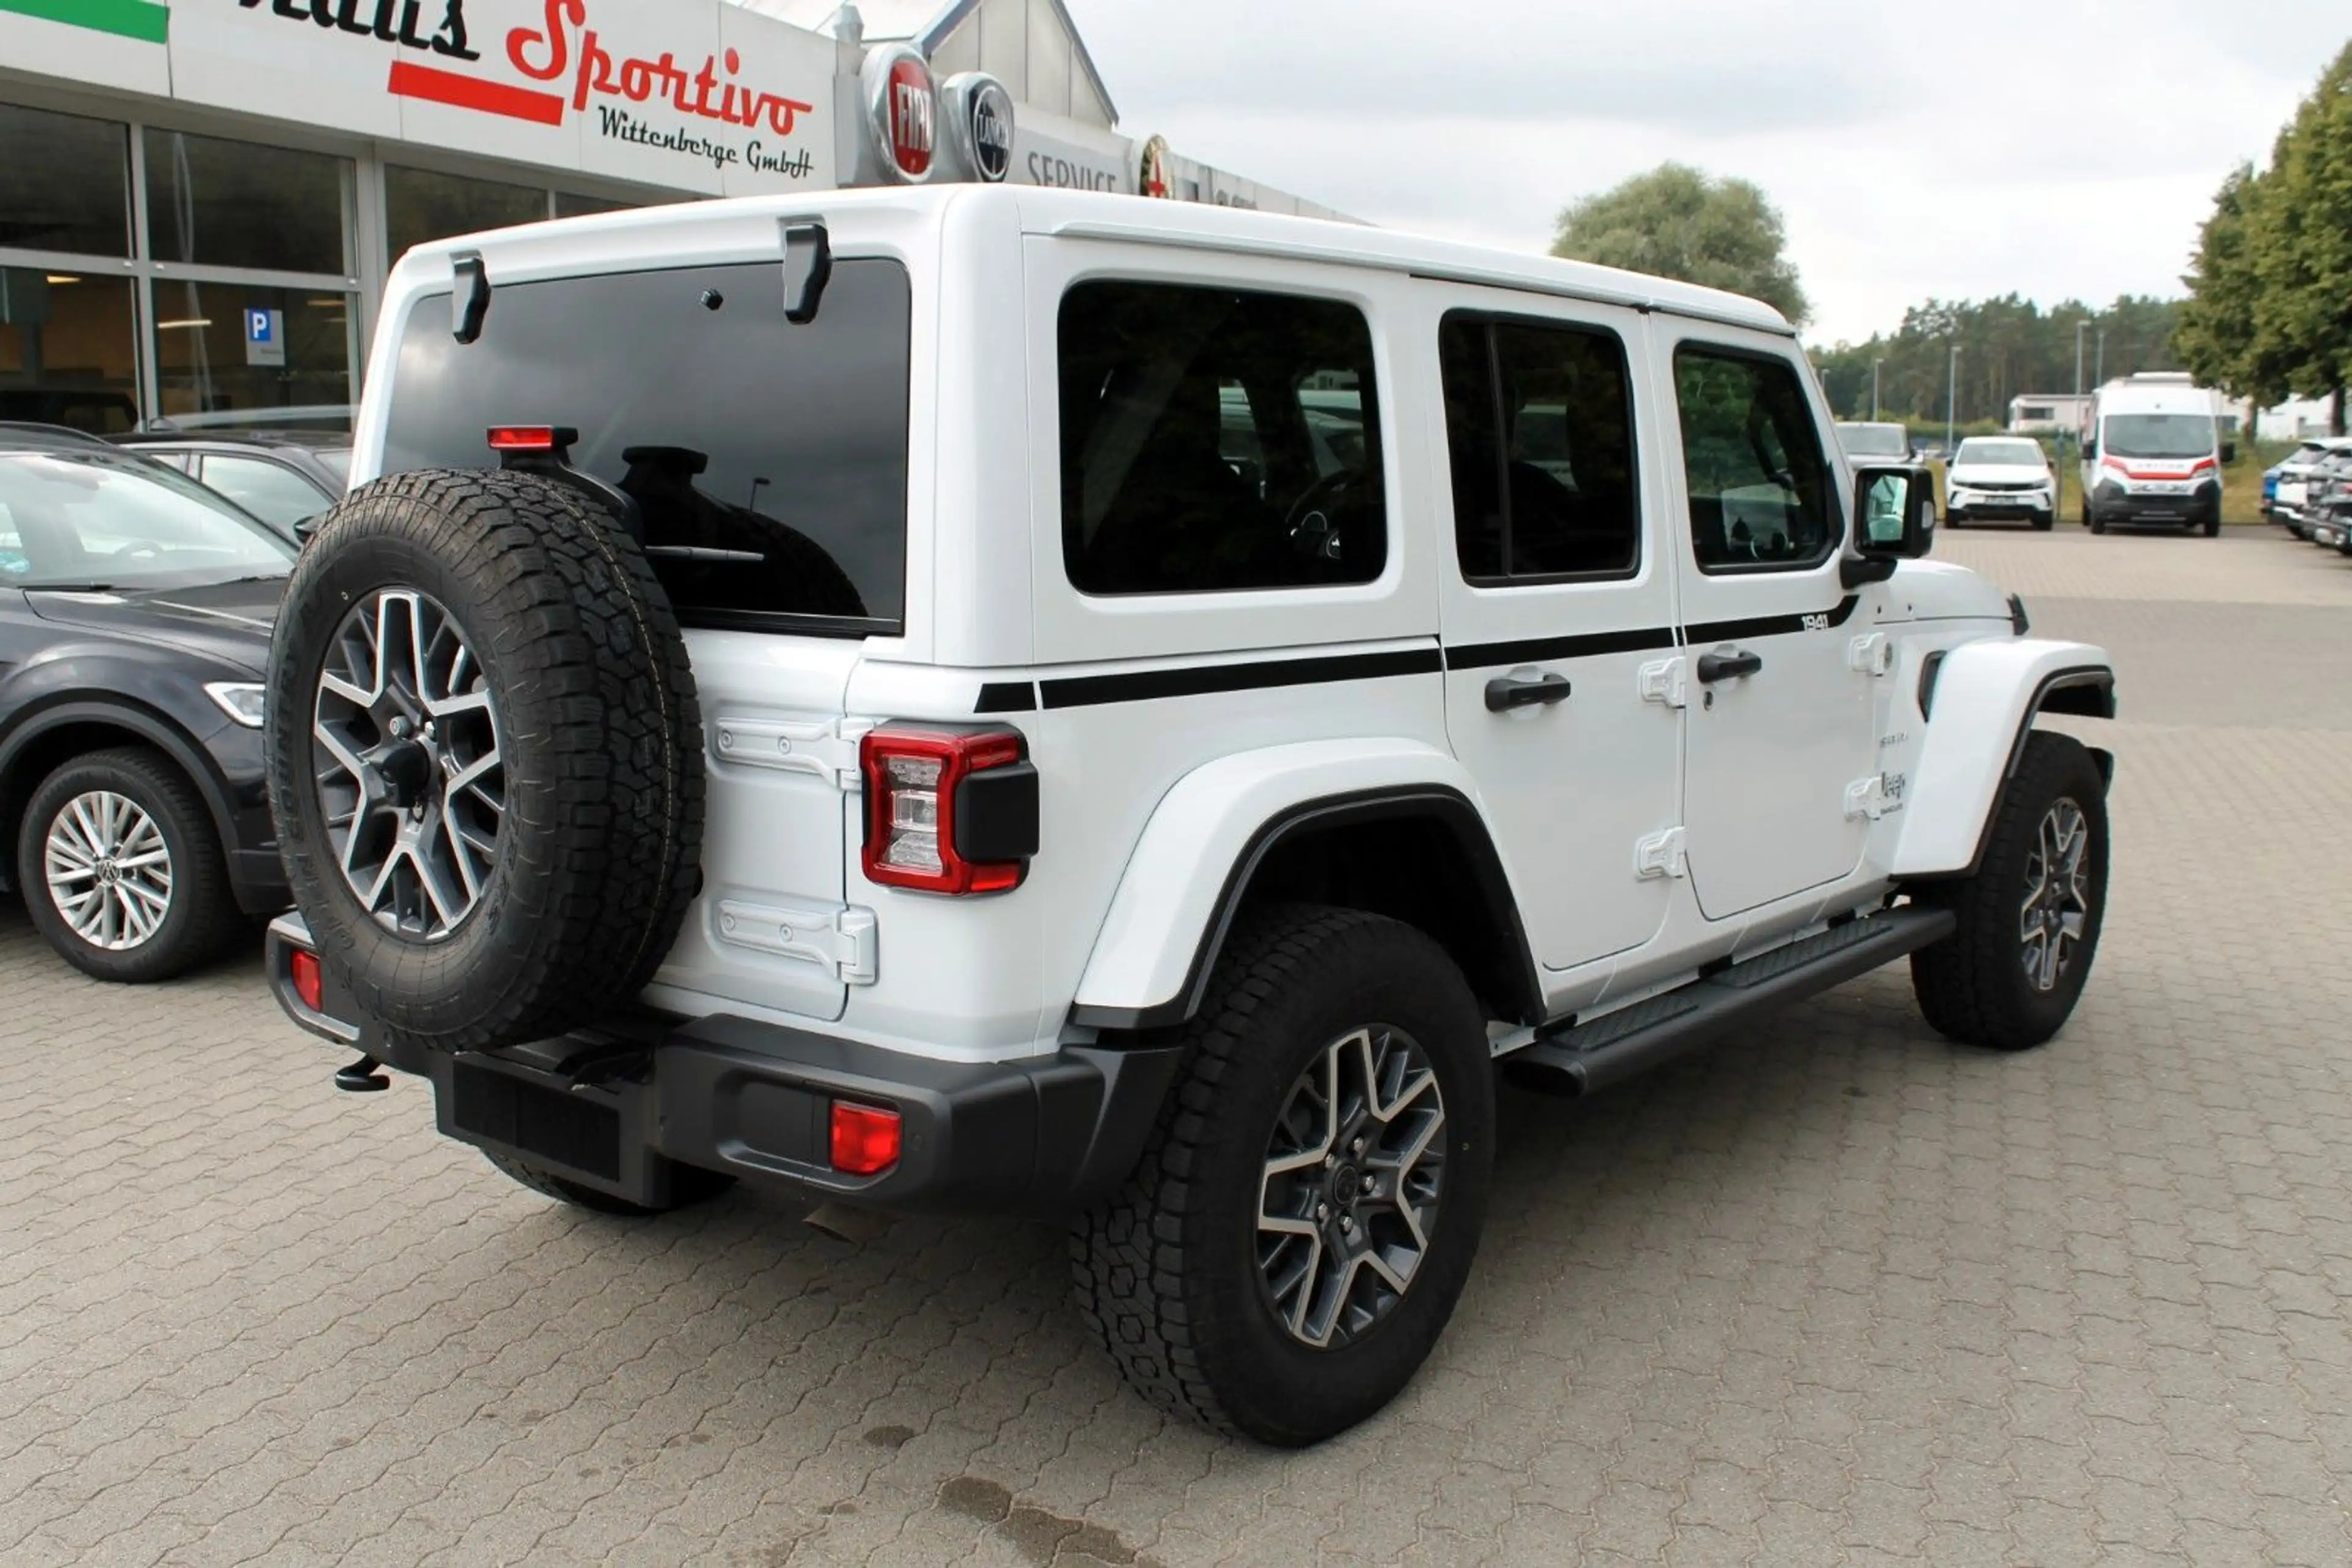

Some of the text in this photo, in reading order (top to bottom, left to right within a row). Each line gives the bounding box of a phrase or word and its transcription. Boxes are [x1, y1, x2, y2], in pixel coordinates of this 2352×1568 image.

[506, 0, 813, 135] Sportivo
[598, 105, 813, 179] Wittenberge GmbH
[253, 313, 267, 338] P
[1801, 614, 1828, 630] 1941
